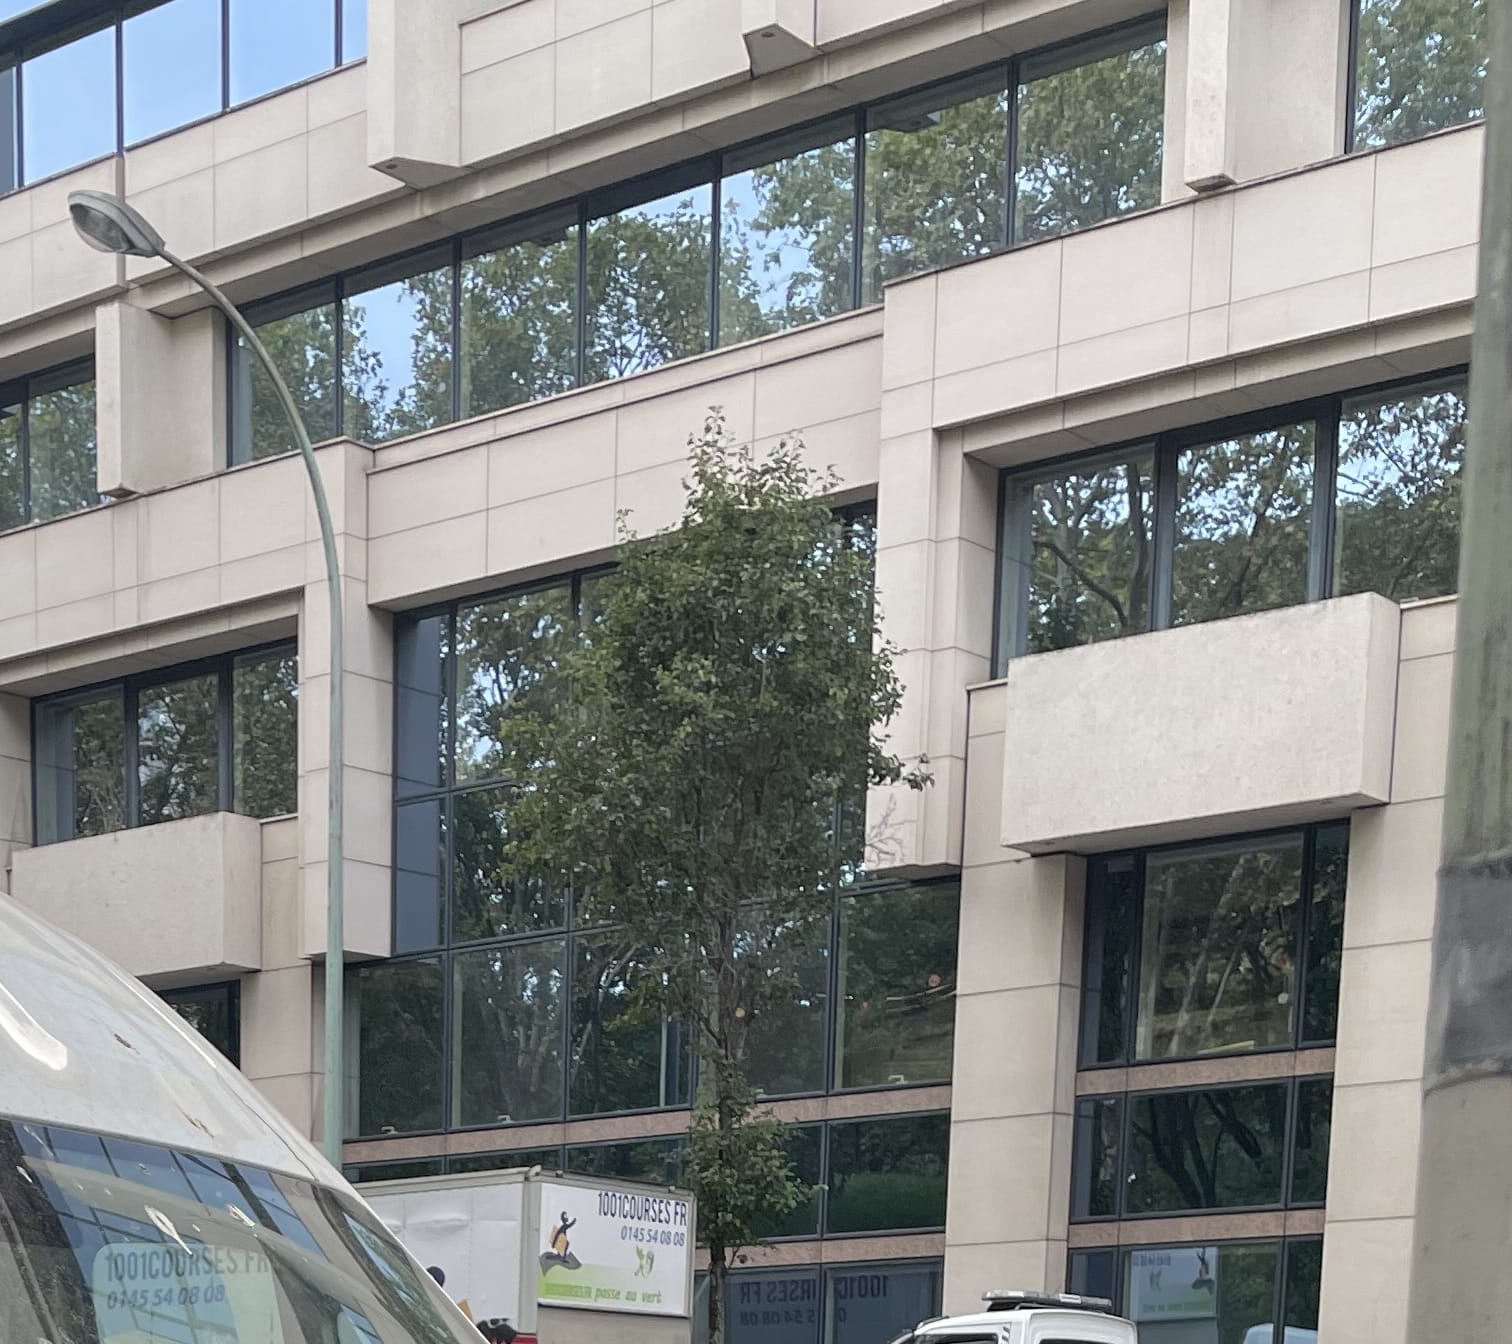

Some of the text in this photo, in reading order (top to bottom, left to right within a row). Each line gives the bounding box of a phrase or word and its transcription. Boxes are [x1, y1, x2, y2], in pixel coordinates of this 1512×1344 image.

[598, 1191, 671, 1225] 1001COURSES
[646, 1229, 658, 1243] 54
[153, 1288, 170, 1306] 54
